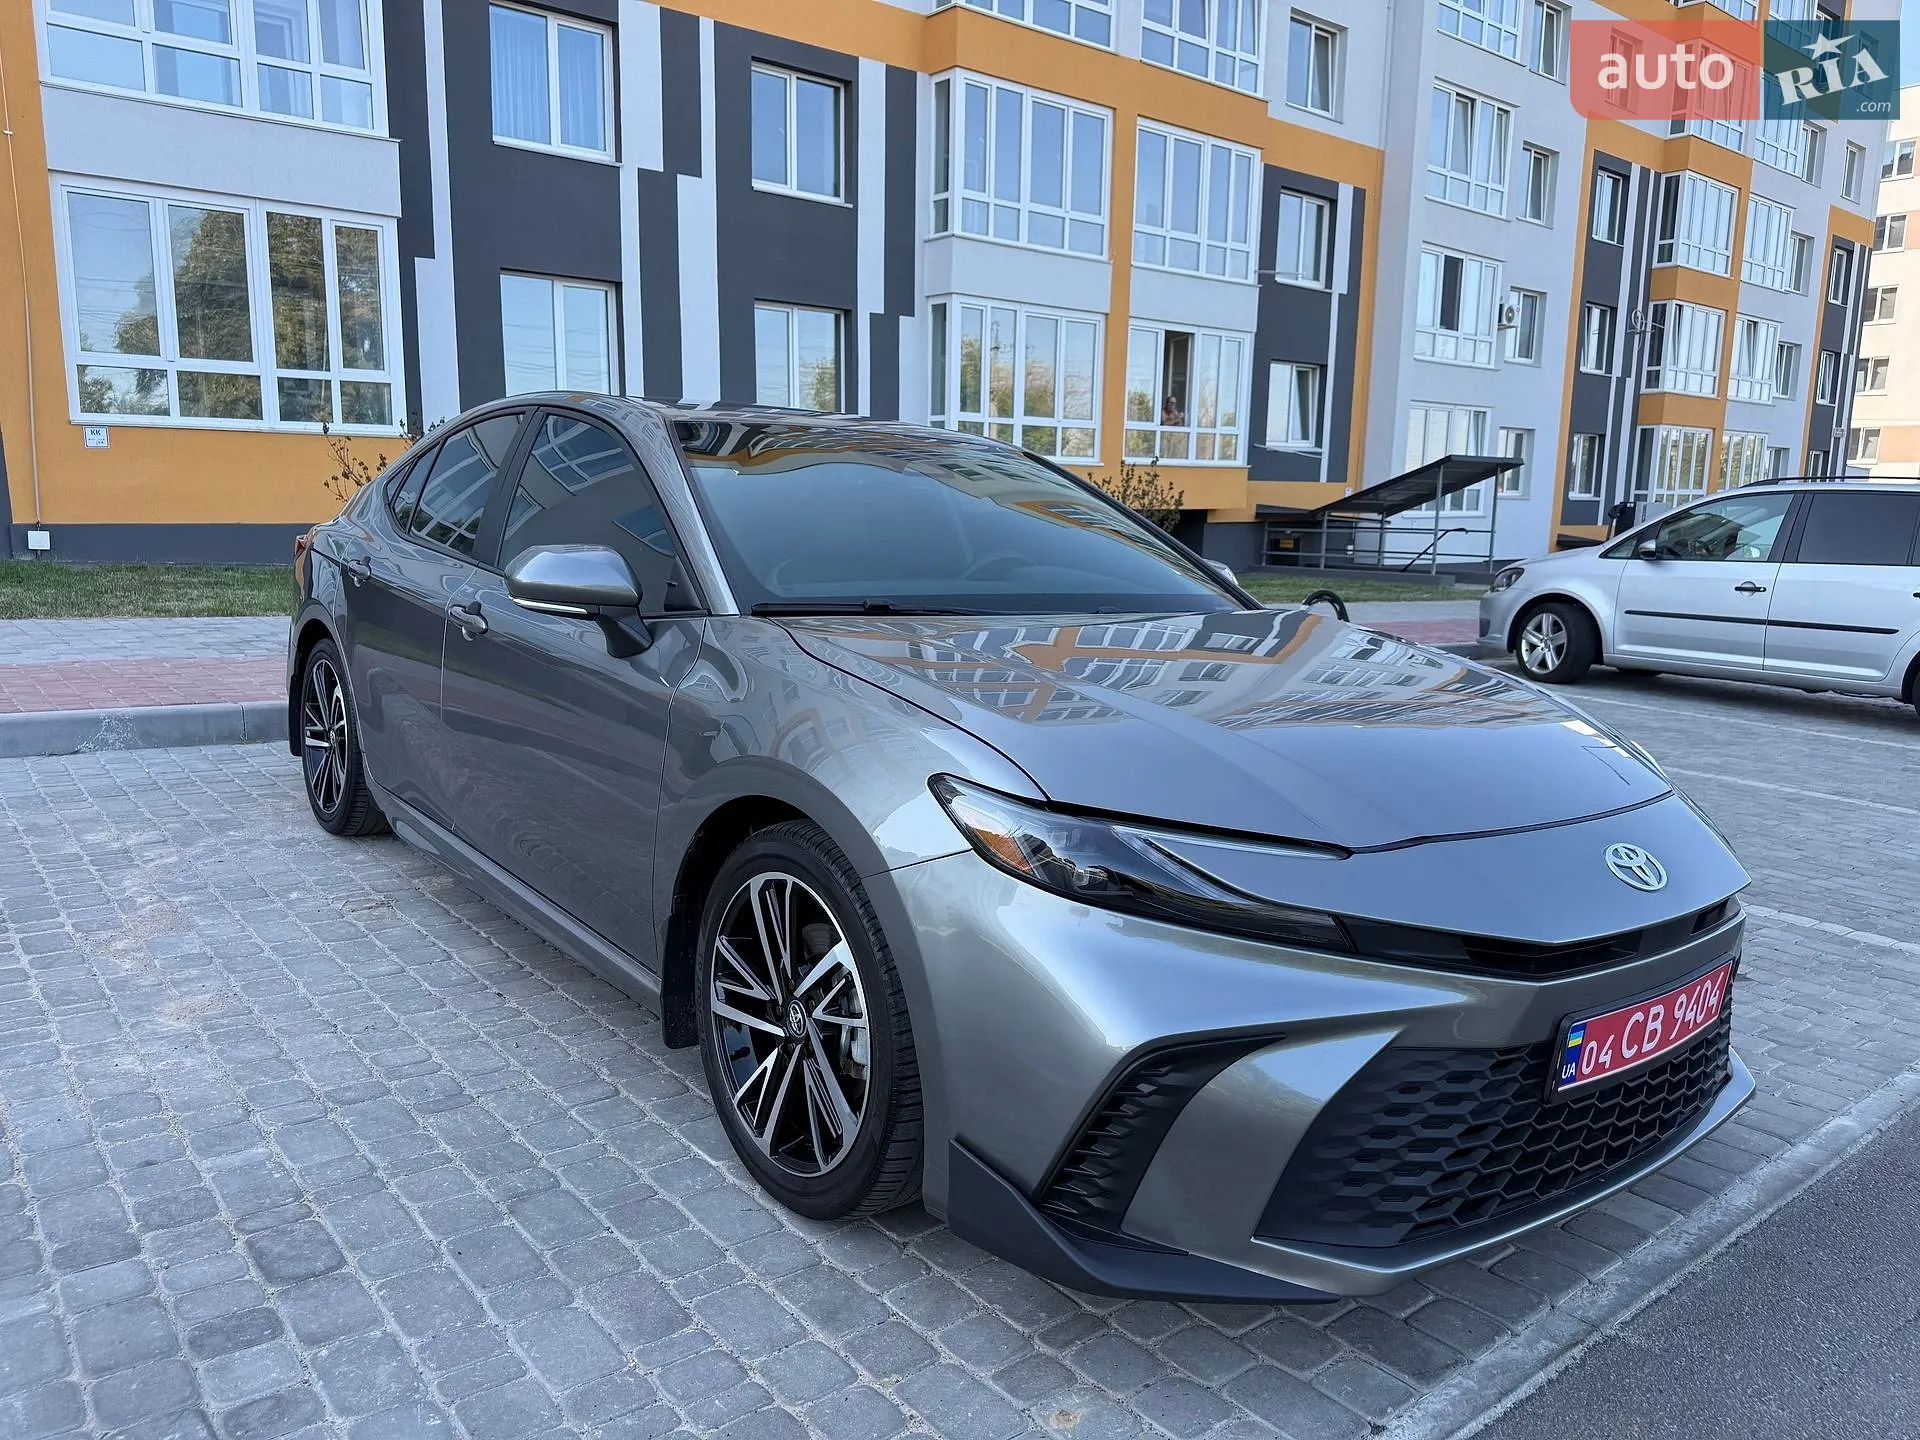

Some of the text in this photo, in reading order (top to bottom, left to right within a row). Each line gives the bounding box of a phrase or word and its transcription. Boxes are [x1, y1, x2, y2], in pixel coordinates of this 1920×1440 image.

[1581, 971, 1724, 1076] 04 CB 9404
[1561, 1062, 1576, 1080] UA
